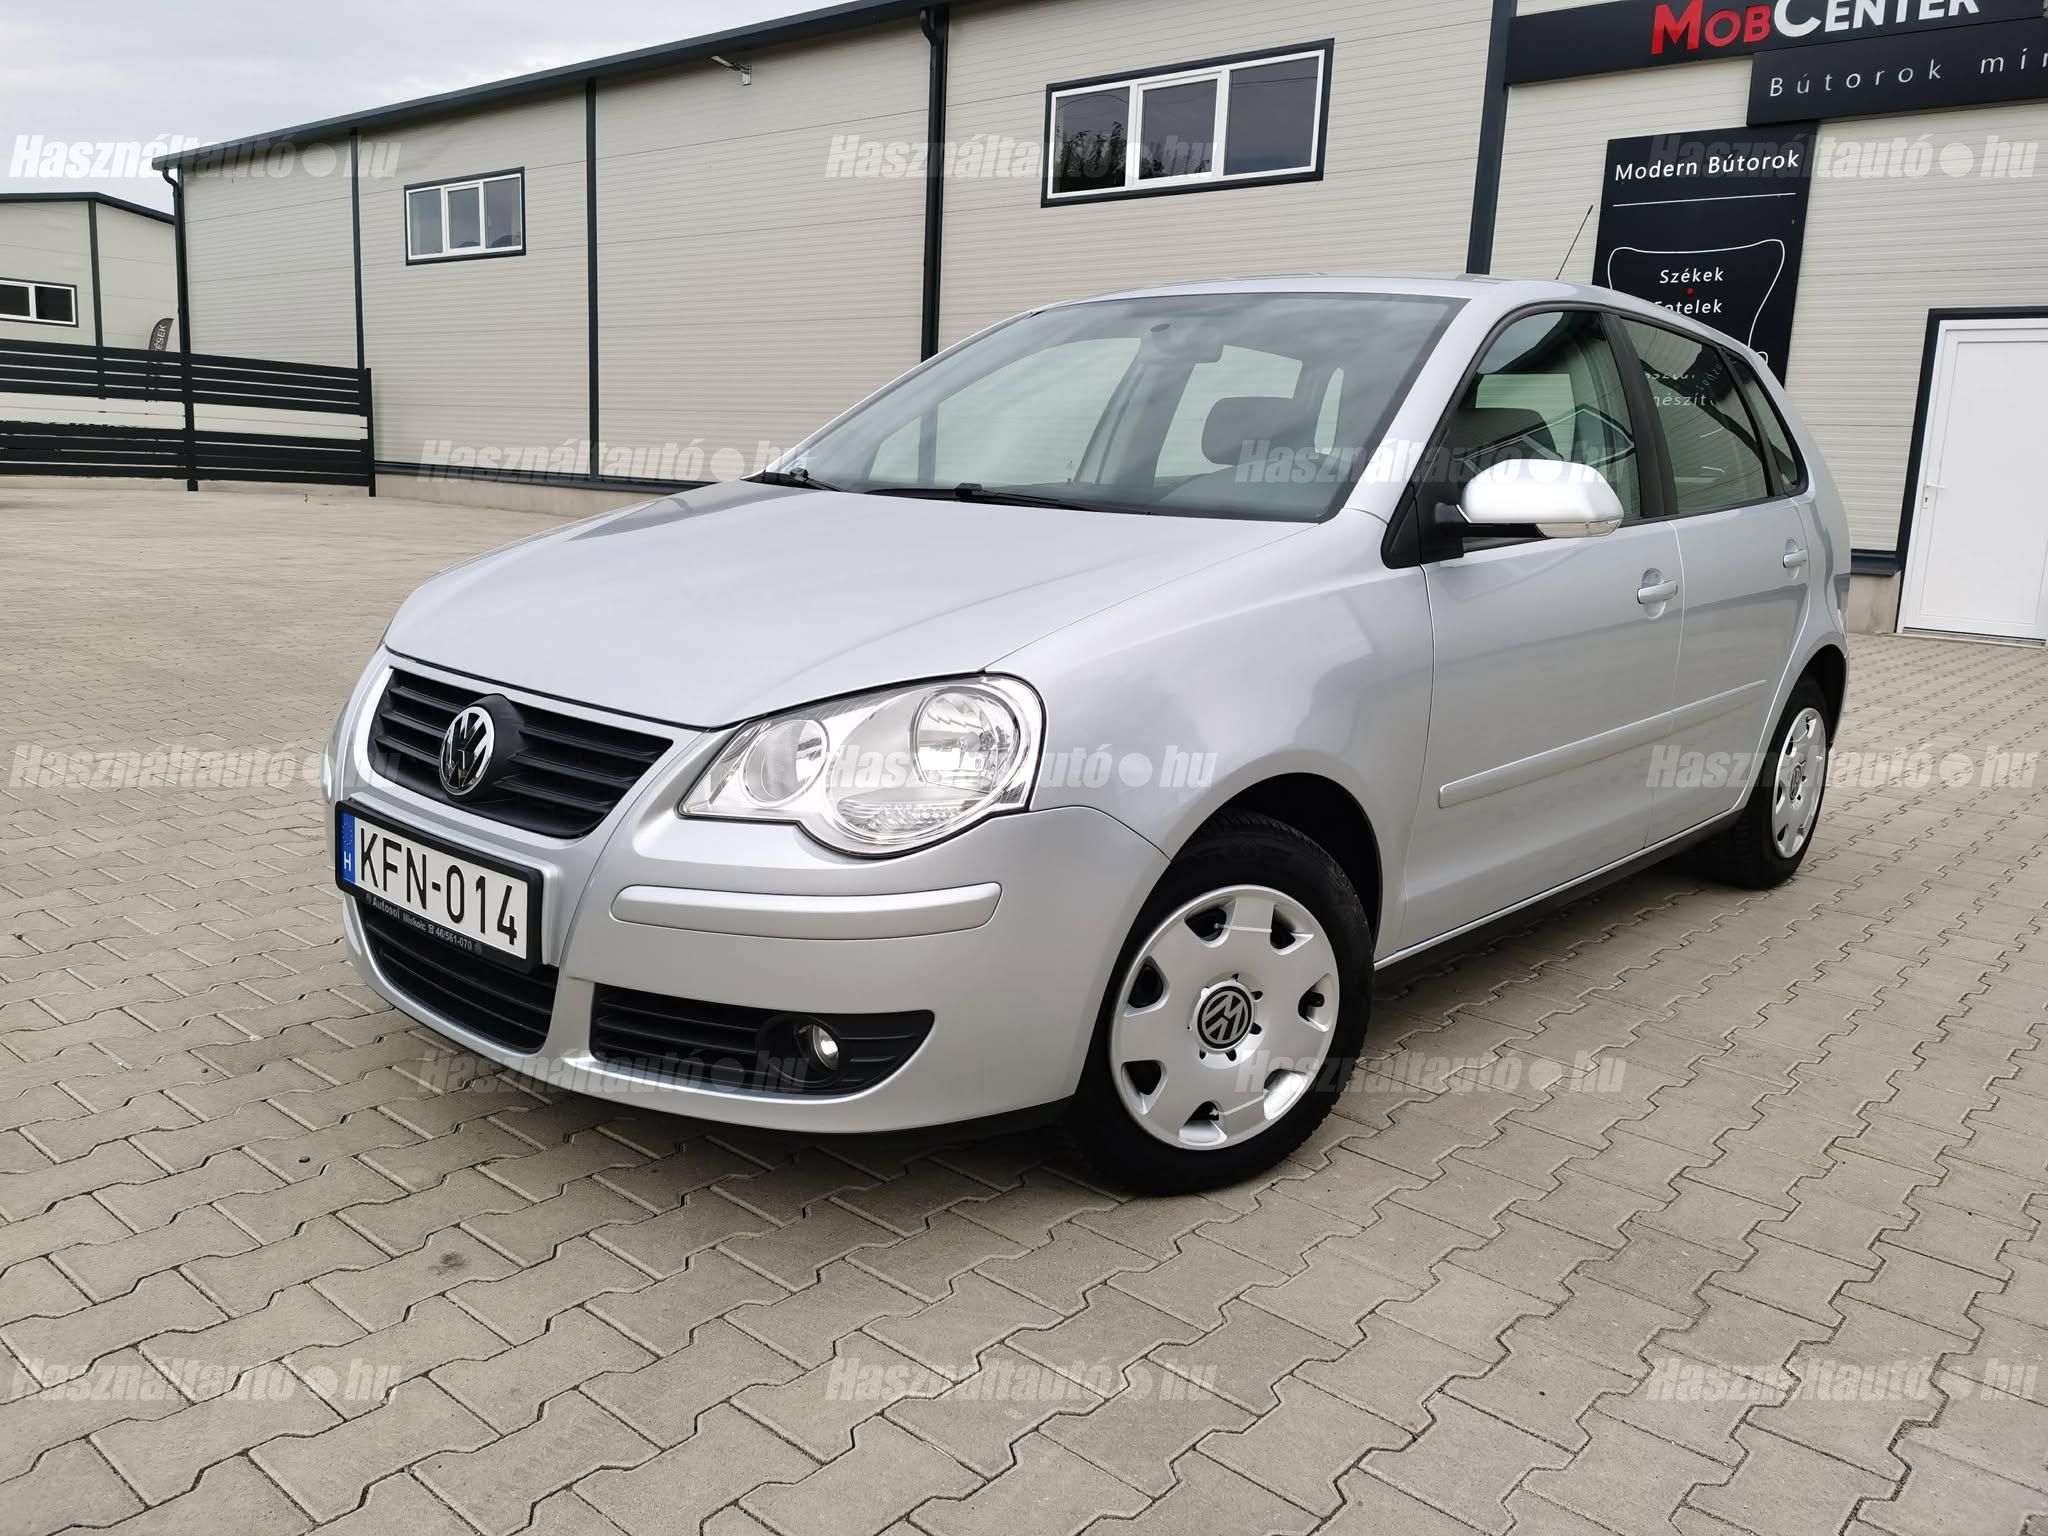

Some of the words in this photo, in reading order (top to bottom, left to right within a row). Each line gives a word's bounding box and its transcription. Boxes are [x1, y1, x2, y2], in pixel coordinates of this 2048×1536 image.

[1769, 58, 1942, 97] Bútorok
[1615, 160, 1698, 181] Modern
[1708, 149, 1800, 174] Bútorok
[1659, 266, 1725, 284] Székek
[343, 851, 352, 873] H
[360, 827, 518, 946] KFN-014
